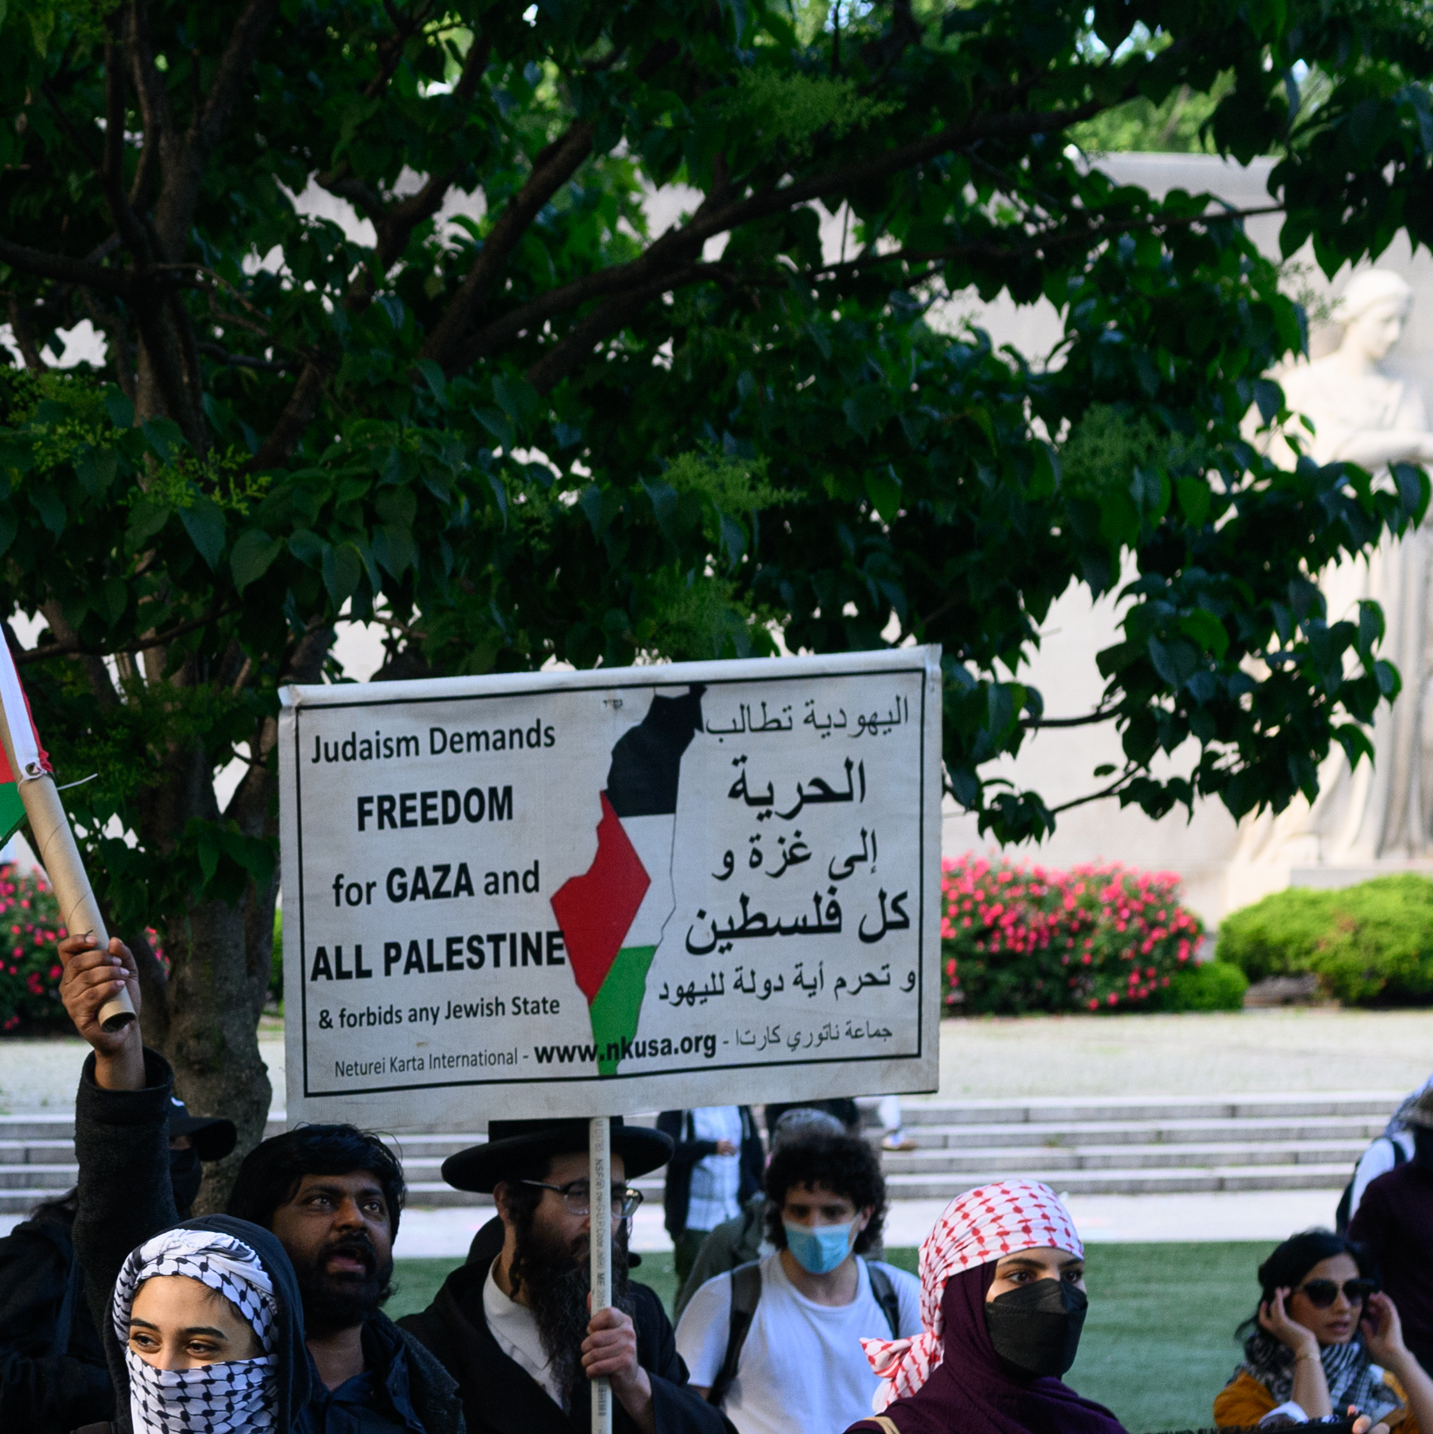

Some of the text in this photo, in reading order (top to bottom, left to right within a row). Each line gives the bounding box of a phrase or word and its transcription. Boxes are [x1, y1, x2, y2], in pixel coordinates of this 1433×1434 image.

[311, 718, 556, 764] Judaism Demands
[705, 695, 909, 743] اليهودية تطالب
[356, 785, 514, 832] FREEDOM
[727, 754, 866, 822] الحرية
[711, 849, 734, 881] و
[748, 829, 812, 879] غزة
[332, 859, 540, 908] for GAZA and
[685, 885, 911, 956] كل فلسطين
[310, 929, 566, 982] ALL PALESTINE
[658, 960, 916, 1007] و تحرم أية دولة لليهود
[318, 996, 560, 1030] & forbids any Jewish State
[845, 1020, 893, 1045] جماعة
[334, 1034, 717, 1078] Neturei Karta International www.nkusa.org
[786, 1022, 840, 1052] ناتوري
